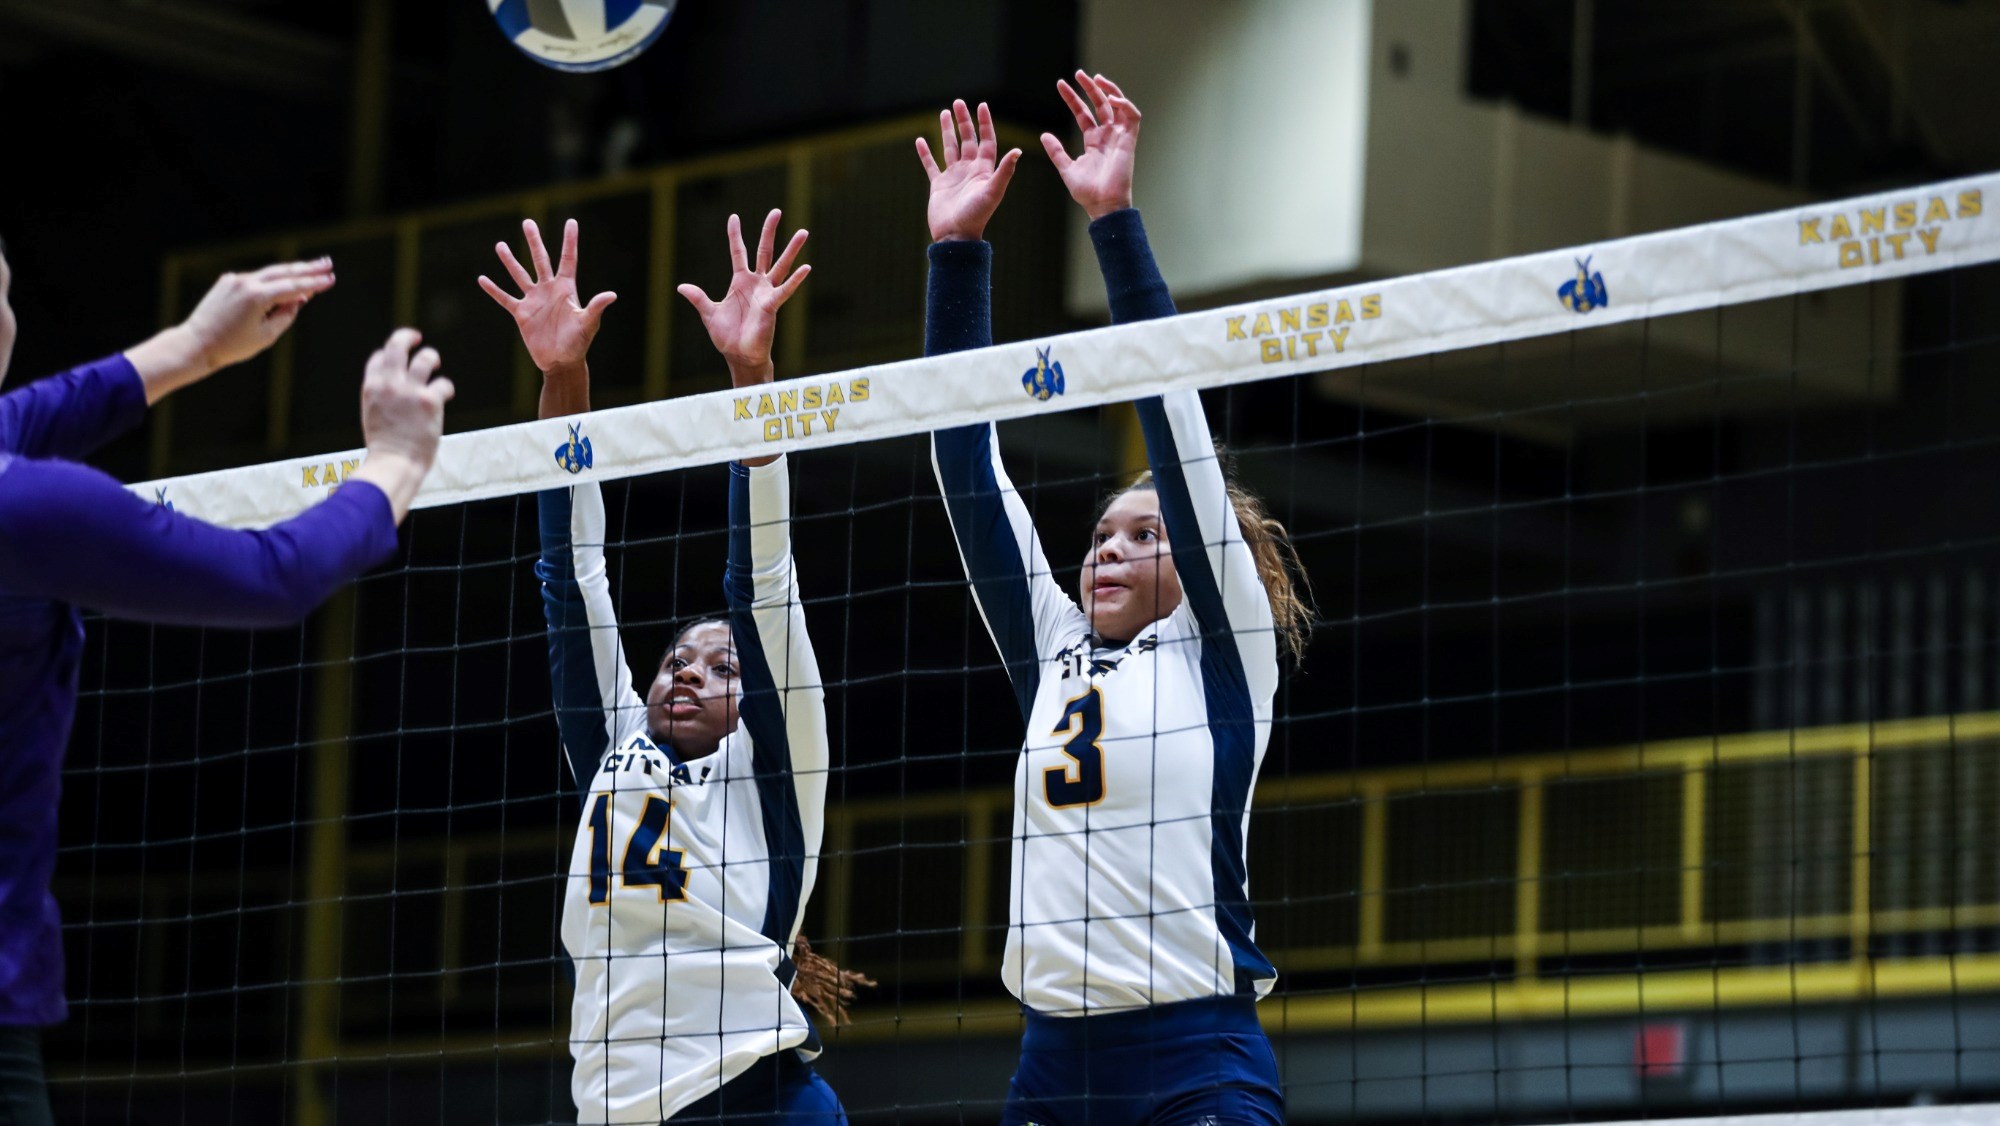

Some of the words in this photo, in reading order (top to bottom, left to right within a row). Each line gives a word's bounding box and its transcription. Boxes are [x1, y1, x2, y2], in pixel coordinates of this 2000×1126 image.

[1798, 188, 1982, 245] KANSAS
[1840, 227, 1940, 268] CITY
[1226, 294, 1382, 341] KANSAS
[1261, 327, 1349, 364] CITY
[734, 378, 870, 420] KANSAS
[764, 408, 840, 442] CITY
[302, 459, 360, 488] KAN
[1042, 685, 1107, 810] 3
[587, 791, 692, 908] 14
